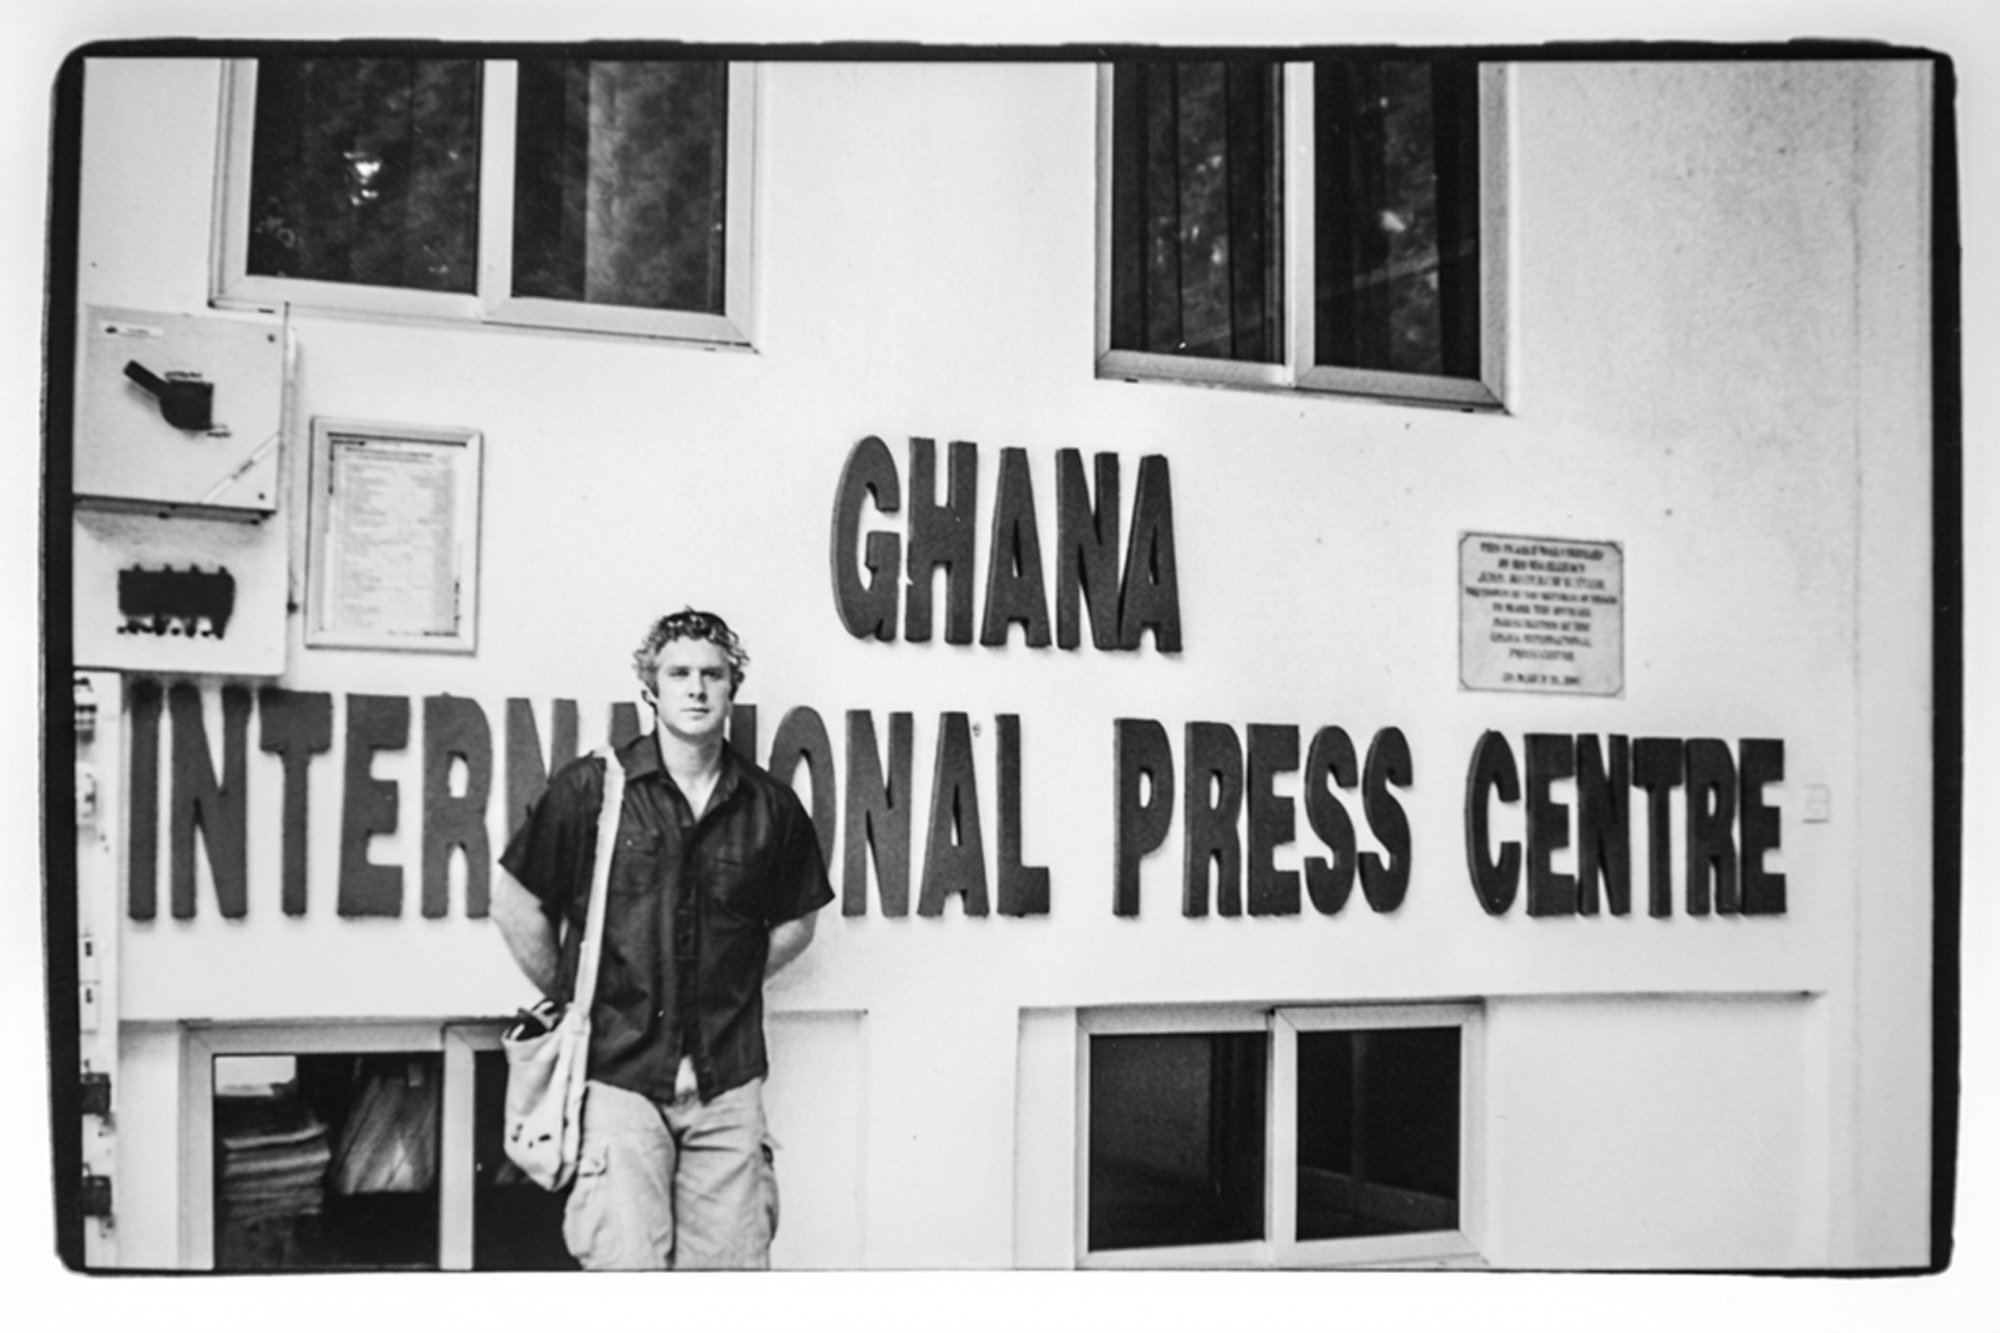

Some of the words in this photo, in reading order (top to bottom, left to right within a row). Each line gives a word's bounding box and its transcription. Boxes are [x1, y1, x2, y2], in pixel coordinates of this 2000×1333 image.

[829, 434, 1183, 653] GHANA
[127, 684, 1051, 920] INTERNONAL
[1112, 717, 1414, 918] PRESS
[1464, 728, 1788, 918] CENTRE
